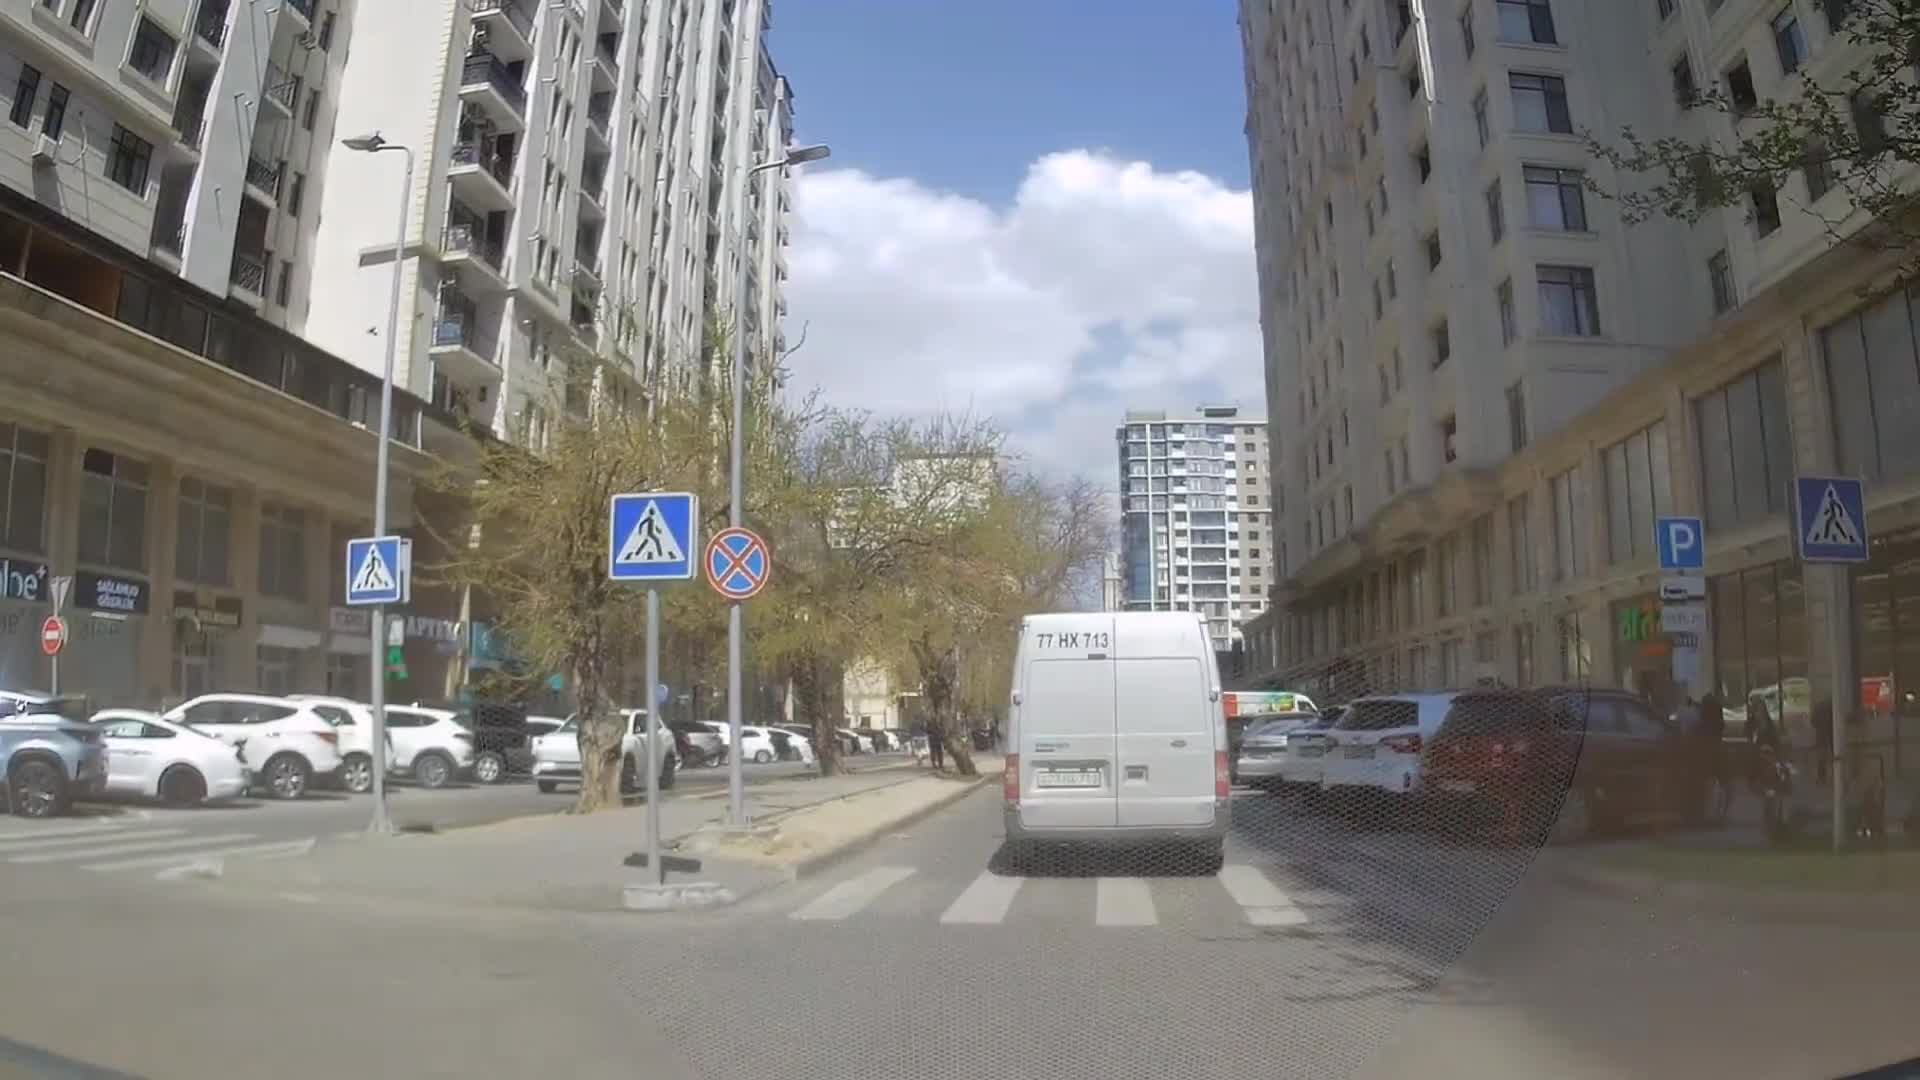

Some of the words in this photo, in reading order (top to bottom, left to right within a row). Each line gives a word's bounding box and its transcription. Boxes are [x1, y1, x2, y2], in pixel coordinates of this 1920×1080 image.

[1670, 523, 1694, 564] P
[1037, 632, 1053, 648] 77
[1059, 632, 1079, 648] HX
[1083, 632, 1109, 648] 713
